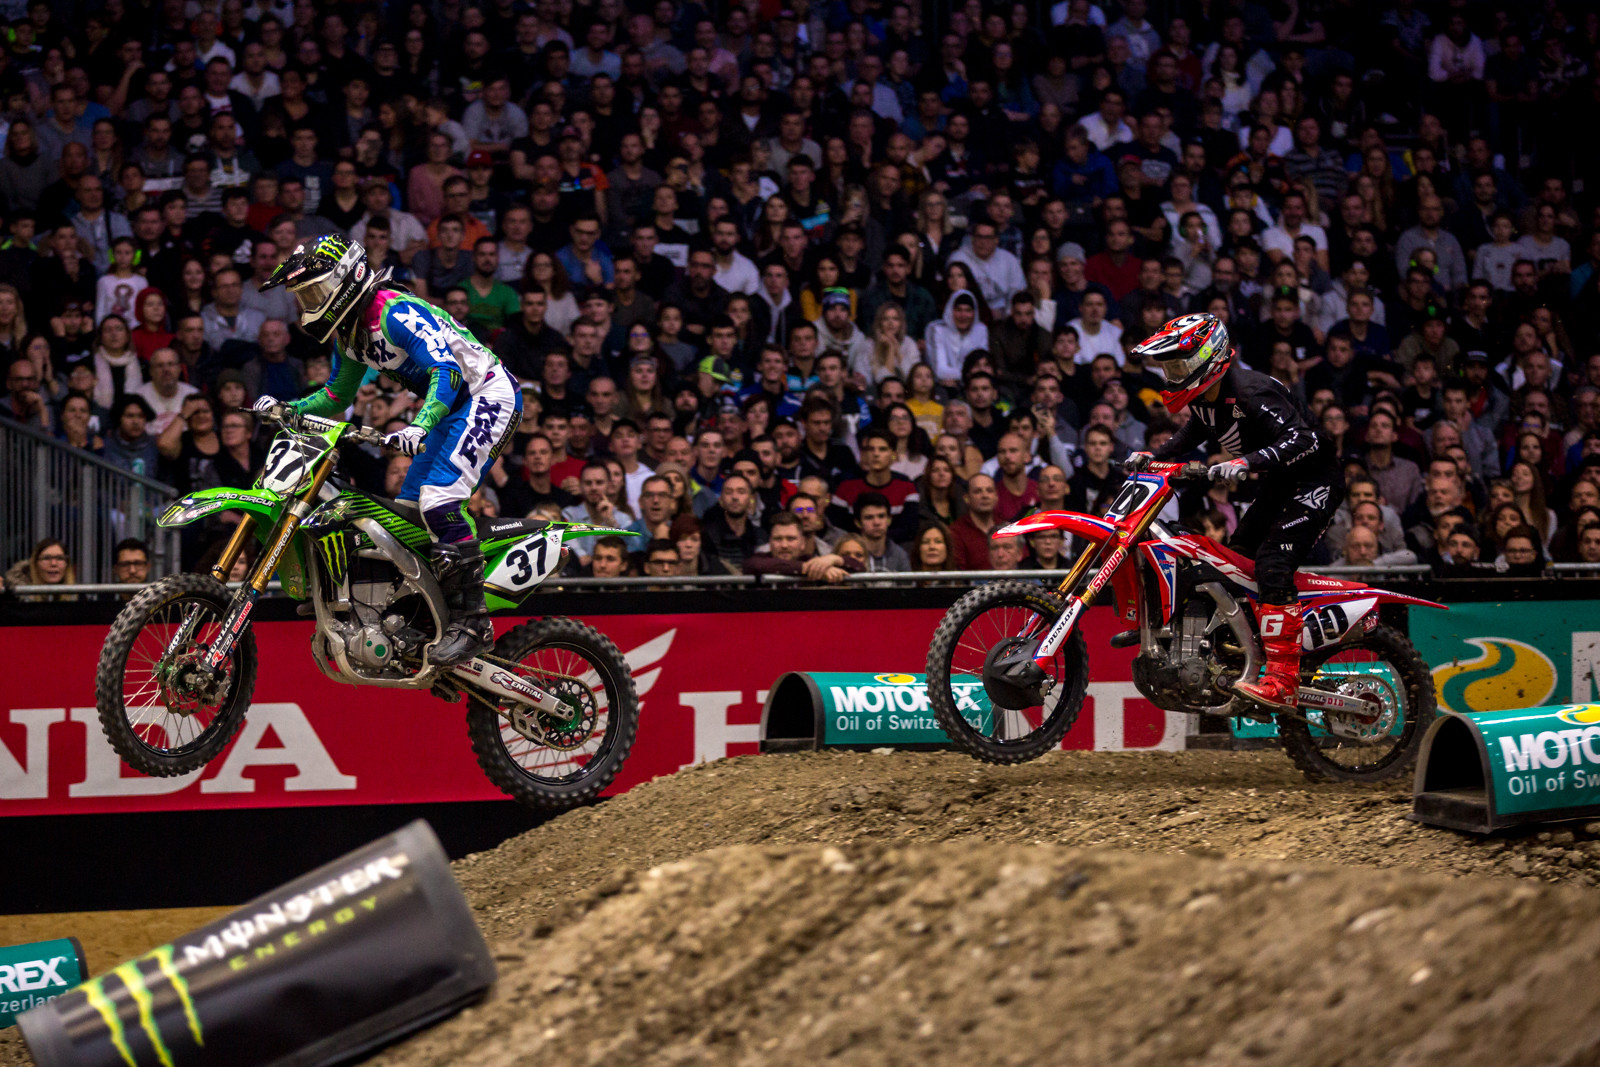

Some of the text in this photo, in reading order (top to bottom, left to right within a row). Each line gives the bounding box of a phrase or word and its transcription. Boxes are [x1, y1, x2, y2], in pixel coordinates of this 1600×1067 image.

[356, 265, 365, 279] BELL
[332, 282, 357, 311] MONSTER
[302, 419, 334, 432] RENTH
[458, 395, 502, 469] FOX
[265, 440, 326, 484] 37
[216, 492, 238, 500] PRO
[490, 521, 524, 533] Kawasaki
[1281, 515, 1310, 530] HONDA
[262, 521, 294, 576] PRO CIRCUIT
[506, 537, 548, 586] 37
[1279, 543, 1294, 551] FLY
[1092, 550, 1123, 592] SHOWA
[1307, 578, 1343, 587] HONDA
[232, 600, 253, 634] BRAKING
[1048, 608, 1074, 645] DUNLOP
[1304, 605, 1349, 650] 10
[204, 609, 236, 663] DUNLOP
[490, 672, 543, 701] RENTHAL
[830, 685, 982, 713] MOTORX
[836, 715, 860, 731] Oil
[865, 714, 883, 730] of
[1508, 776, 1537, 795] Oil
[1545, 772, 1566, 792] of
[184, 852, 410, 966] MONSTER
[228, 896, 379, 972] ENERGY
[0, 988, 70, 1014] zerla
